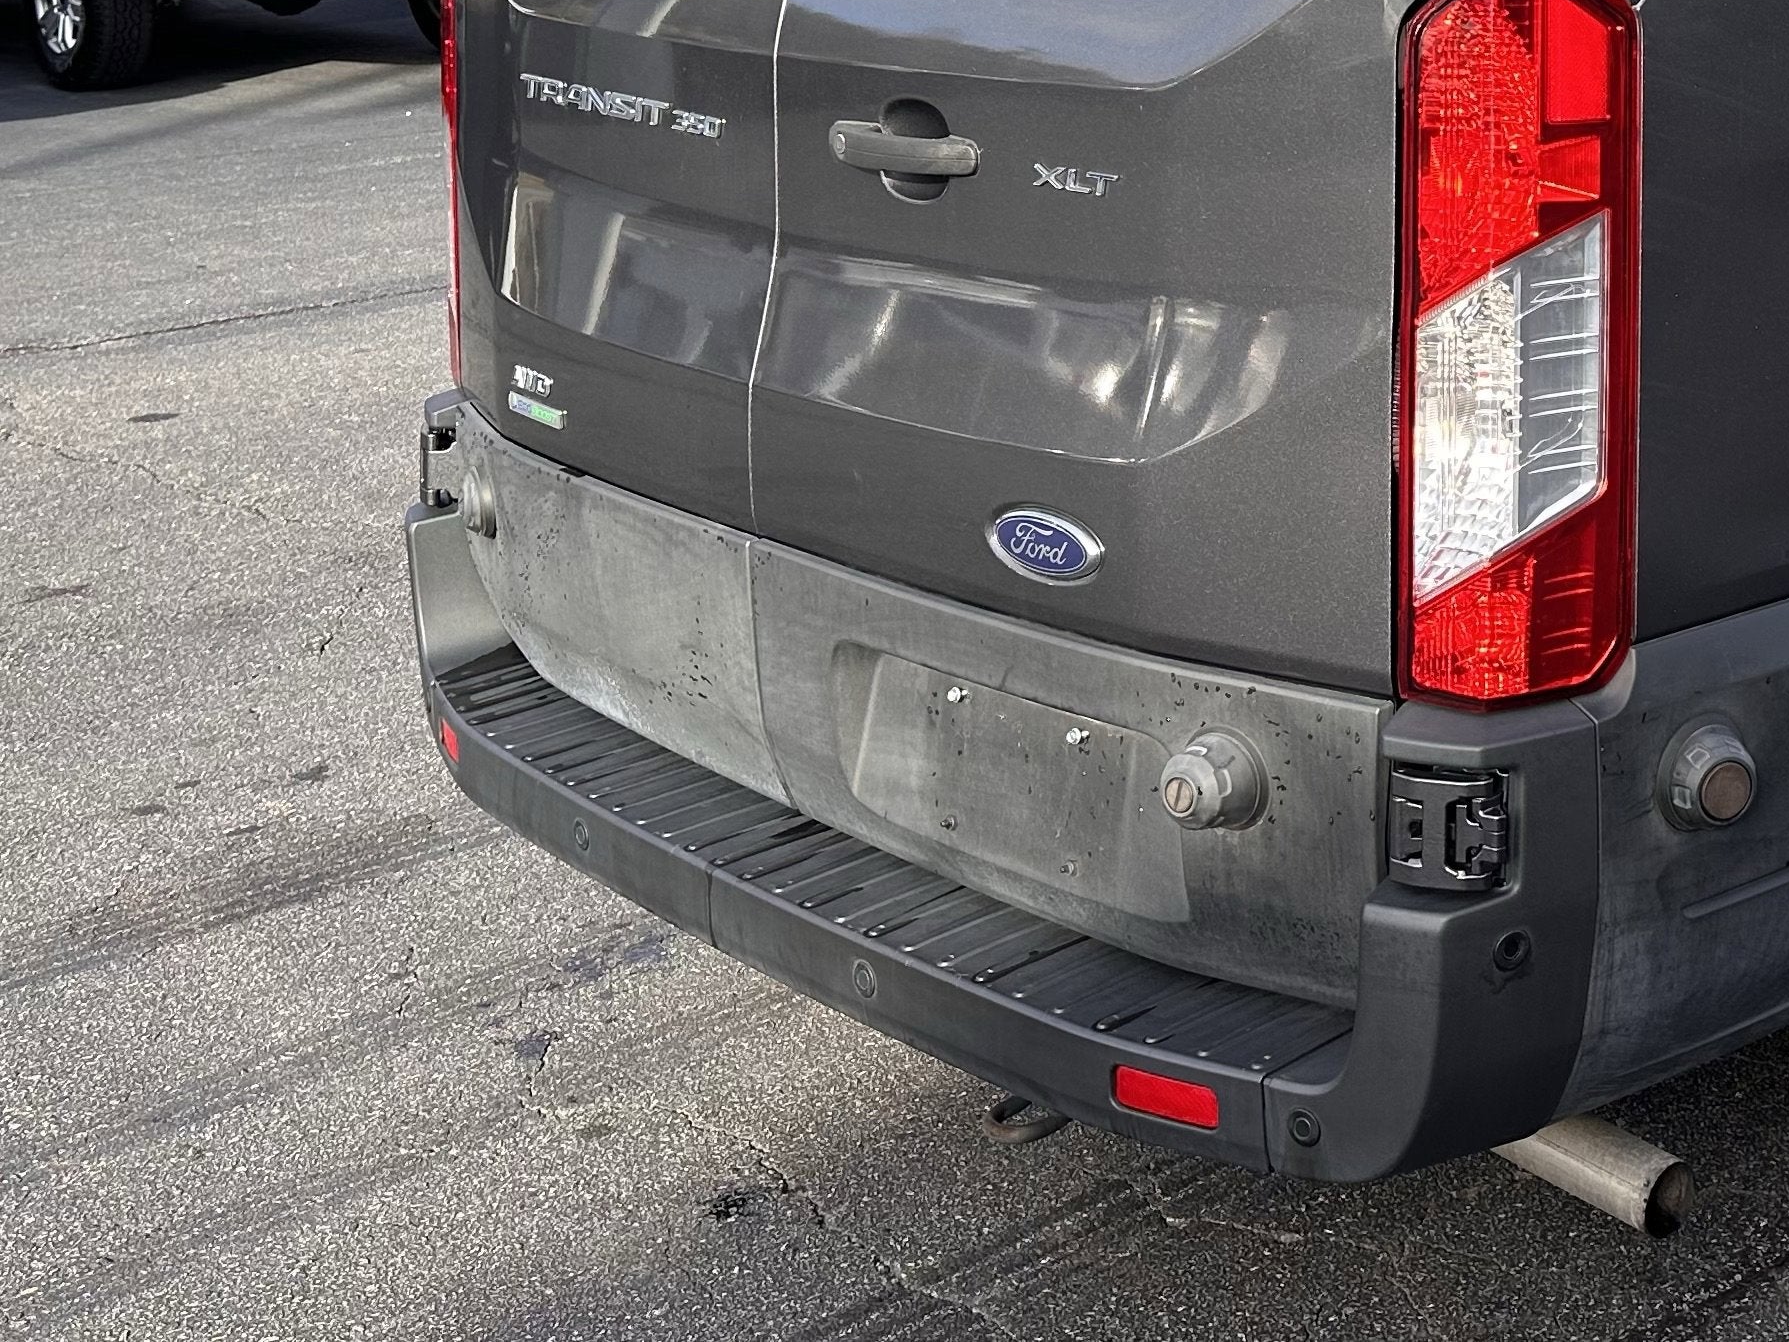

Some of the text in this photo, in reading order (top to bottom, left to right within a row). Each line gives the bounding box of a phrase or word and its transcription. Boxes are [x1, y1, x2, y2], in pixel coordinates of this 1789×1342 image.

[520, 73, 727, 139] TRANSIT 350
[1033, 162, 1122, 197] XLT
[1010, 522, 1069, 565] Ford
